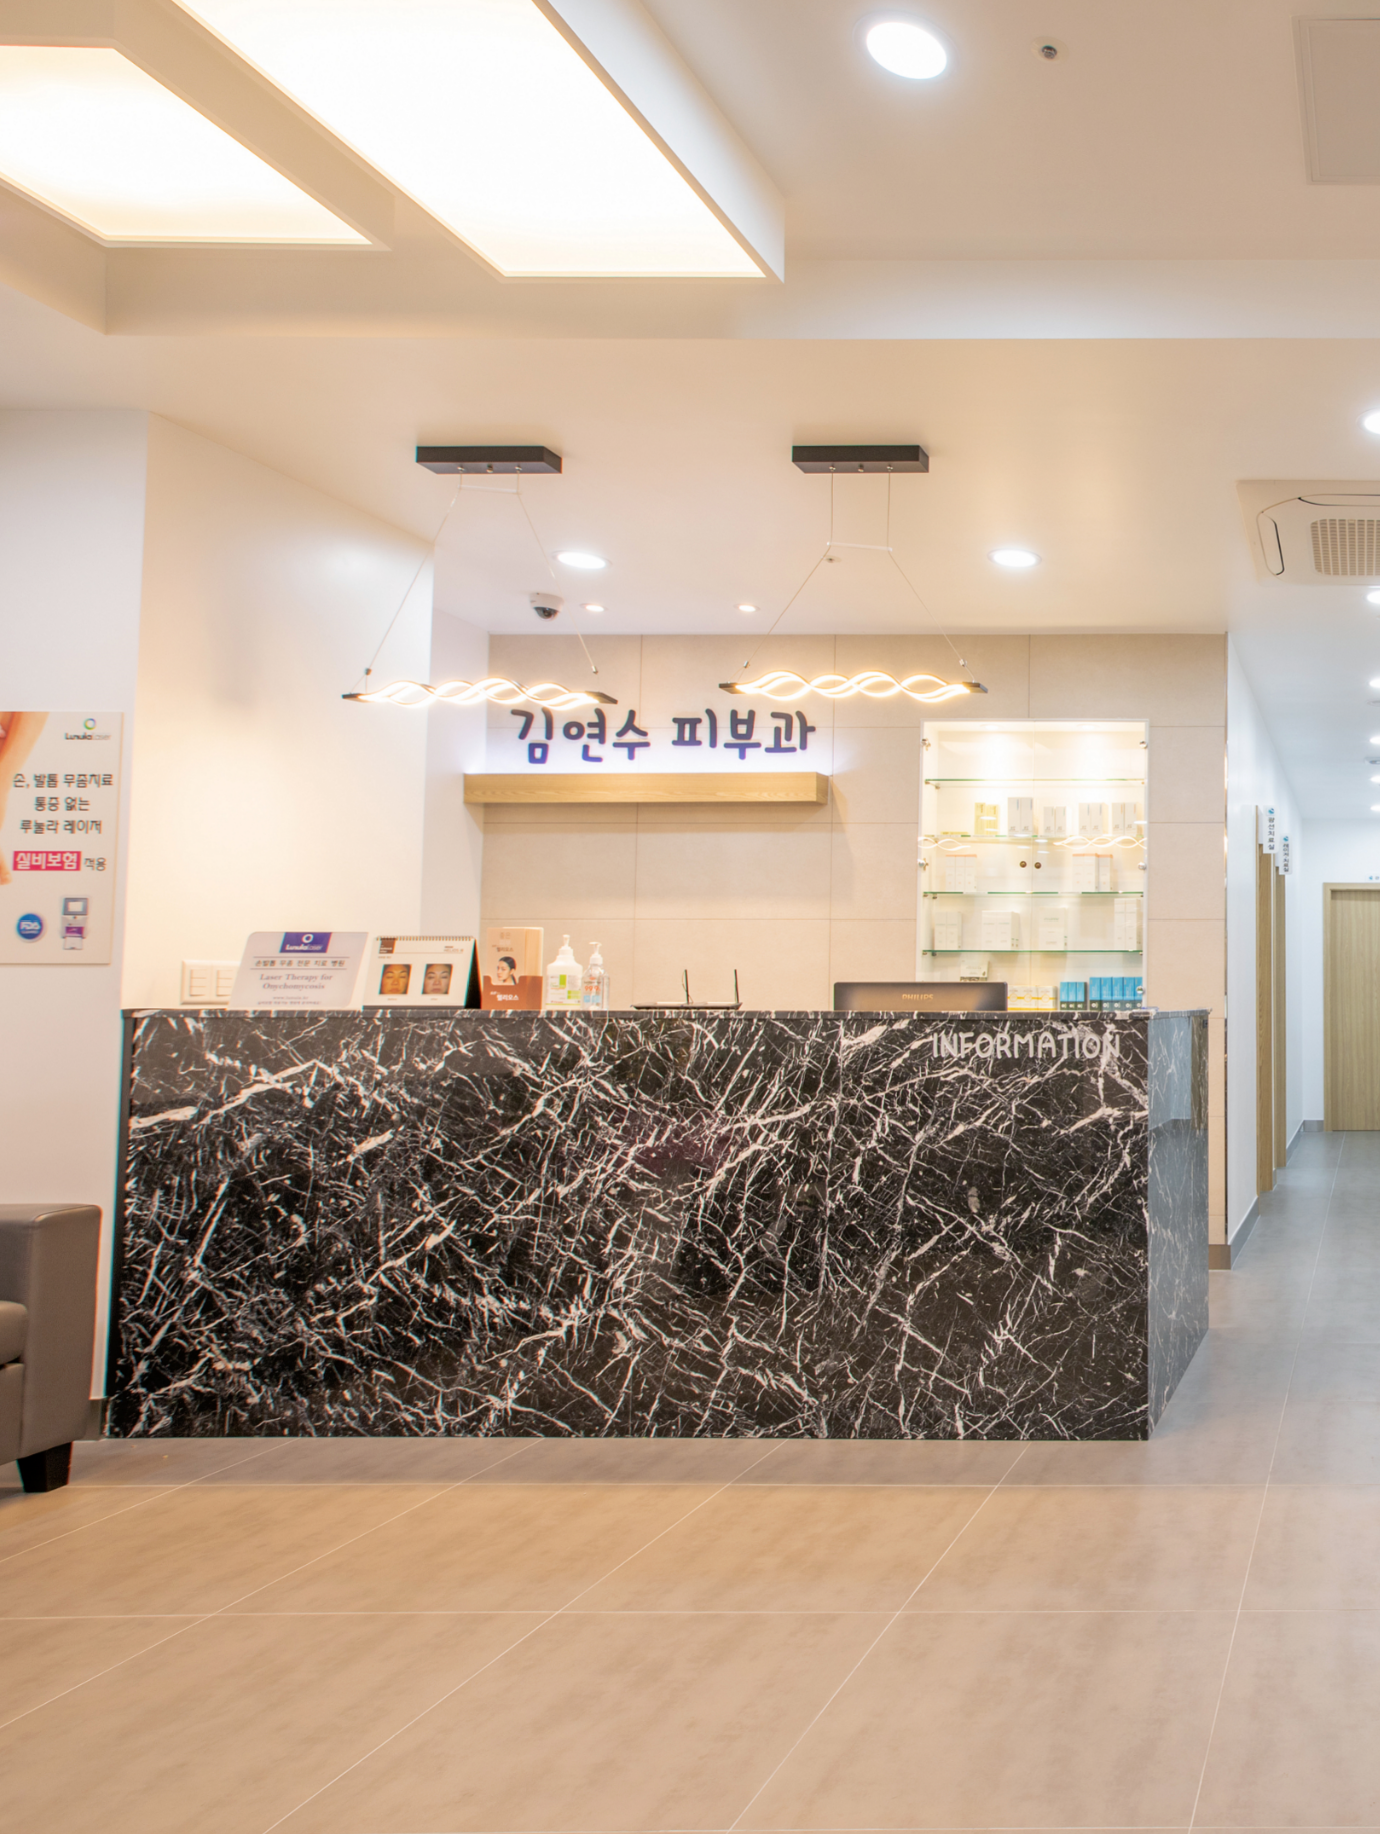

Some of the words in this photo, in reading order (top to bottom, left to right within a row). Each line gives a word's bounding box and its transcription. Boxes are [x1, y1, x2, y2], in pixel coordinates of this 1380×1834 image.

[511, 707, 650, 764] 김연수
[672, 708, 816, 760] 피부과
[33, 774, 58, 788] 발톱
[64, 773, 113, 787] 무좀치료
[35, 797, 59, 811] 통증
[64, 797, 90, 811] 없는
[20, 820, 59, 834] 루눌라
[64, 820, 102, 834] 레이저
[16, 852, 78, 870] 실비보험
[84, 857, 106, 871] 적용
[285, 974, 318, 982] Therapy
[262, 983, 325, 991] Onychomycosis
[932, 1032, 1120, 1058] INFORMATION
